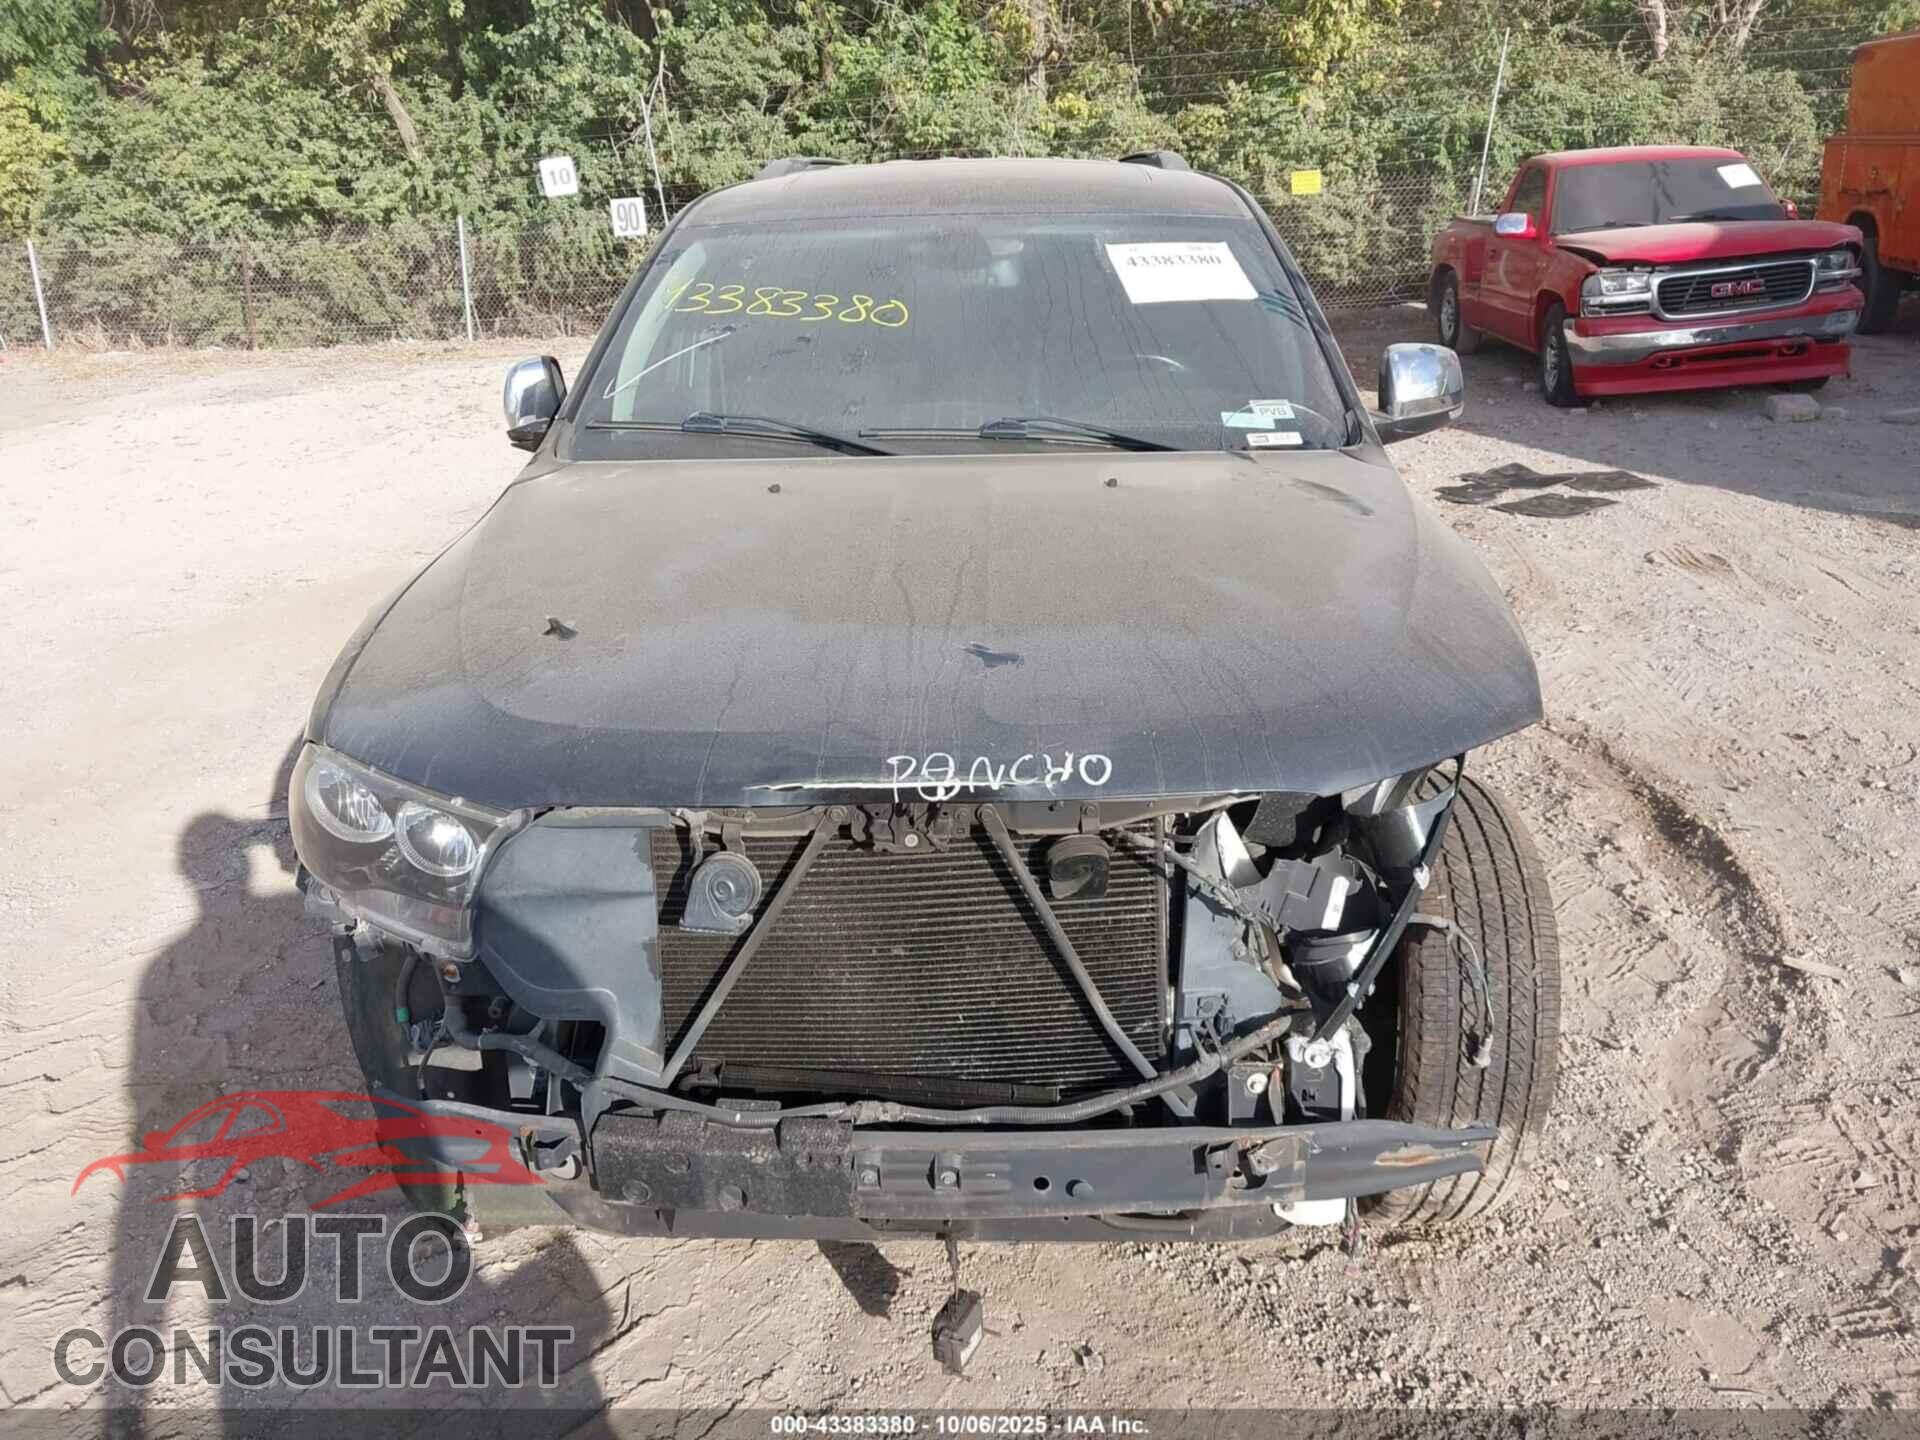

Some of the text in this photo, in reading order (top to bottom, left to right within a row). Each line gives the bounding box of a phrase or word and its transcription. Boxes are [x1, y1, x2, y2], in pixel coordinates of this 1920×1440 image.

[549, 168, 571, 186] 10
[616, 202, 640, 232] 90
[1127, 255, 1222, 267] 43383380
[1711, 279, 1766, 298] GMC
